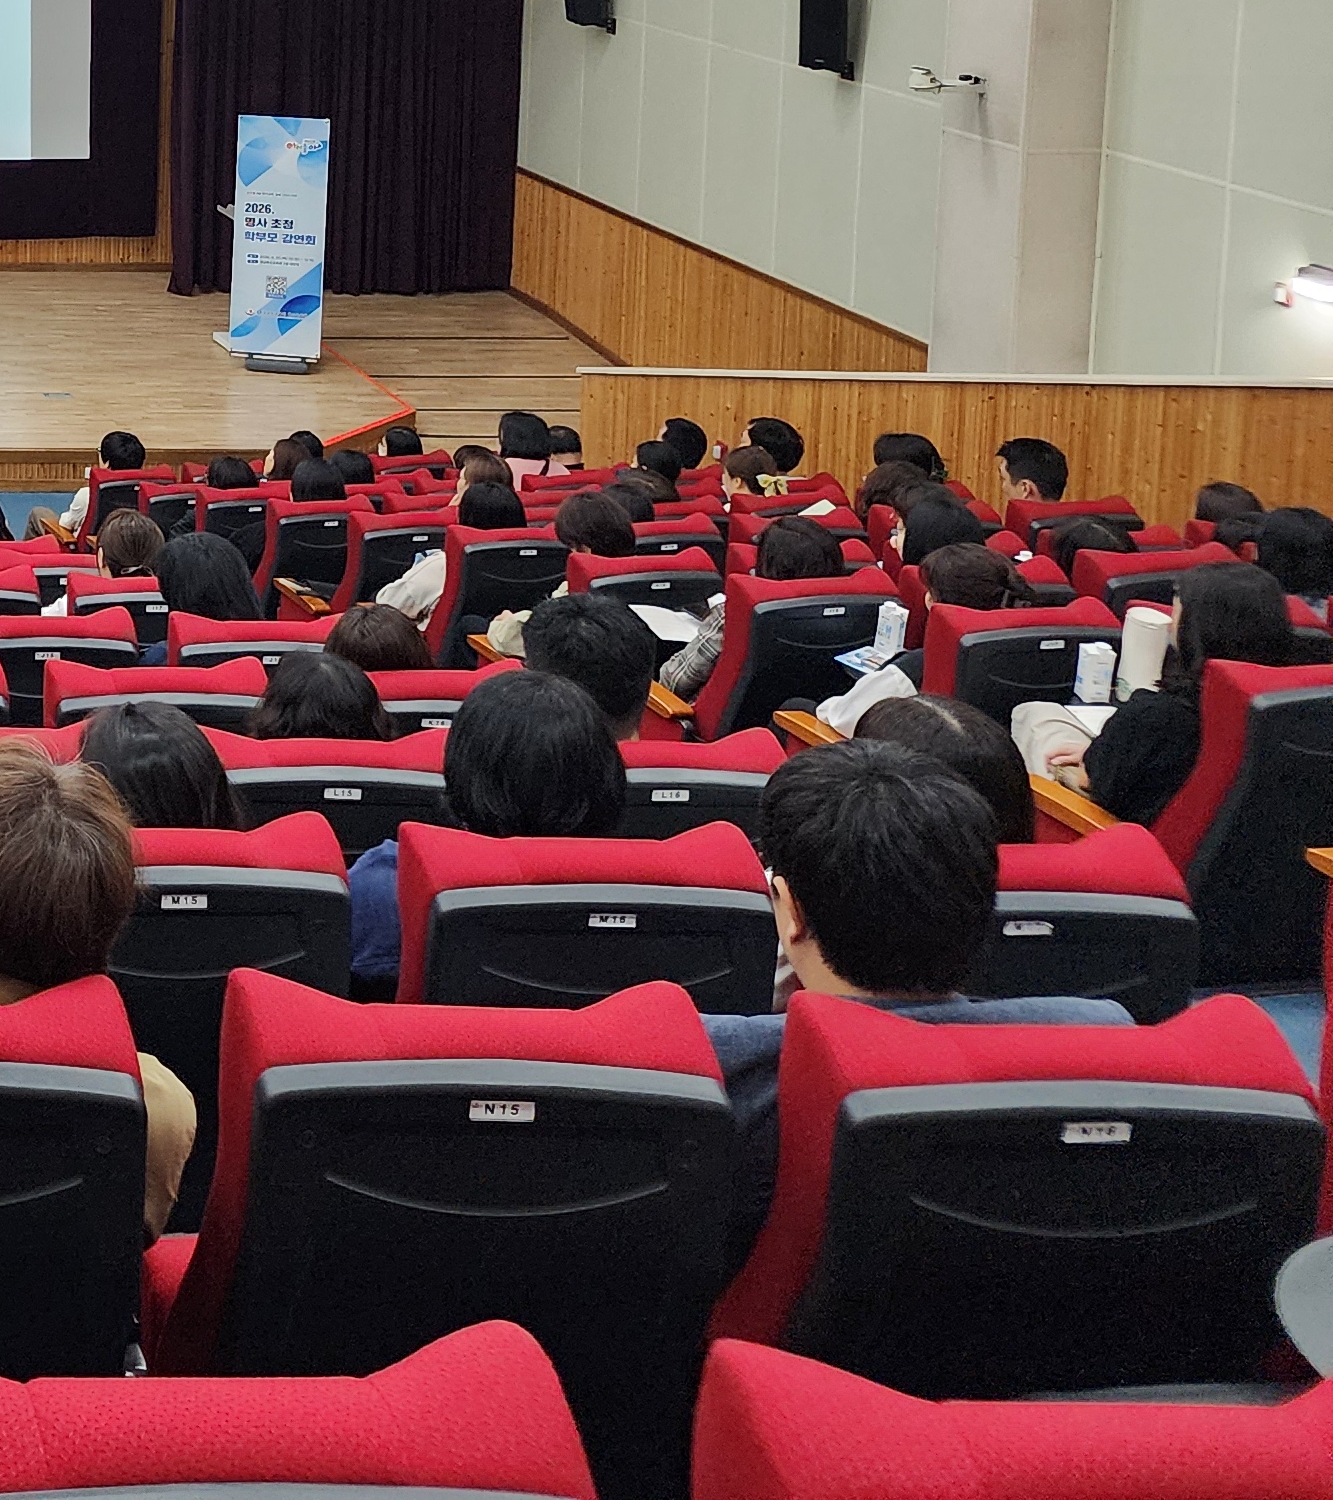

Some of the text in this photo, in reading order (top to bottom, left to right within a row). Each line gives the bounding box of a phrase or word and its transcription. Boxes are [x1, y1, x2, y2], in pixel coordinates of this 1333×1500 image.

[244, 202, 275, 215] 2026.
[244, 216, 268, 228] 명사
[333, 789, 353, 797] L15
[171, 896, 198, 905] M15
[483, 1103, 521, 1116] N15
